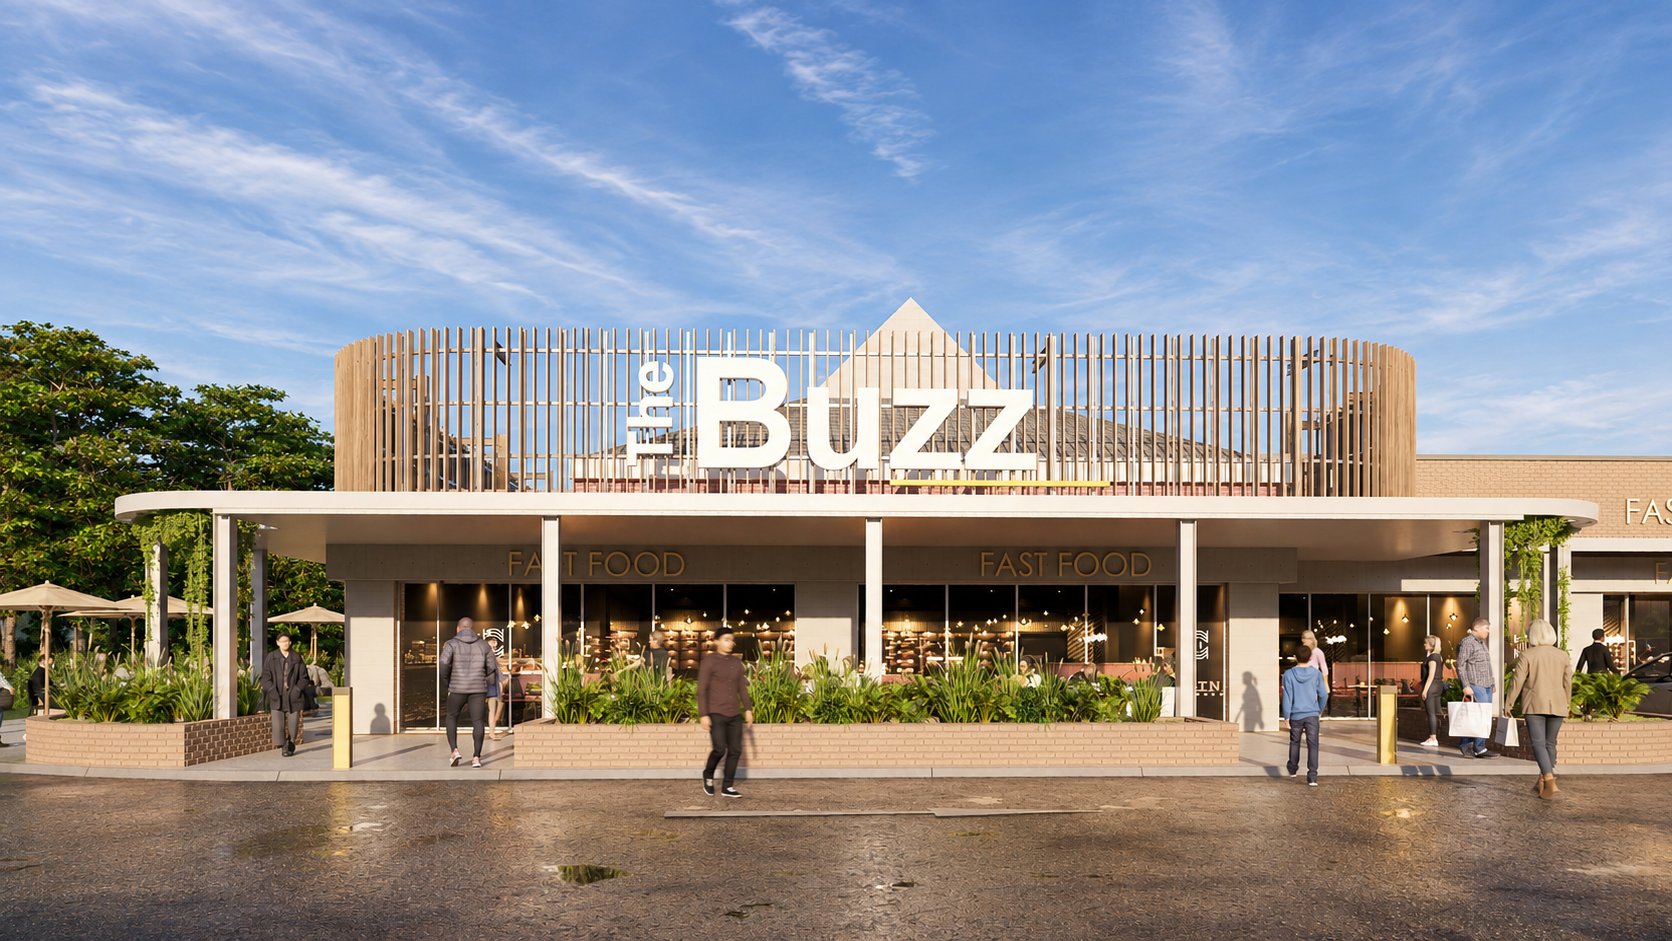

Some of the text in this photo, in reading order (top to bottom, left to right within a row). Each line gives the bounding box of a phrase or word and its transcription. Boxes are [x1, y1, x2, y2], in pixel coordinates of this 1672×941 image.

[627, 356, 1038, 472] The Buzz
[508, 551, 685, 577] FAT FOOD
[980, 551, 1152, 577] FAST FOOD
